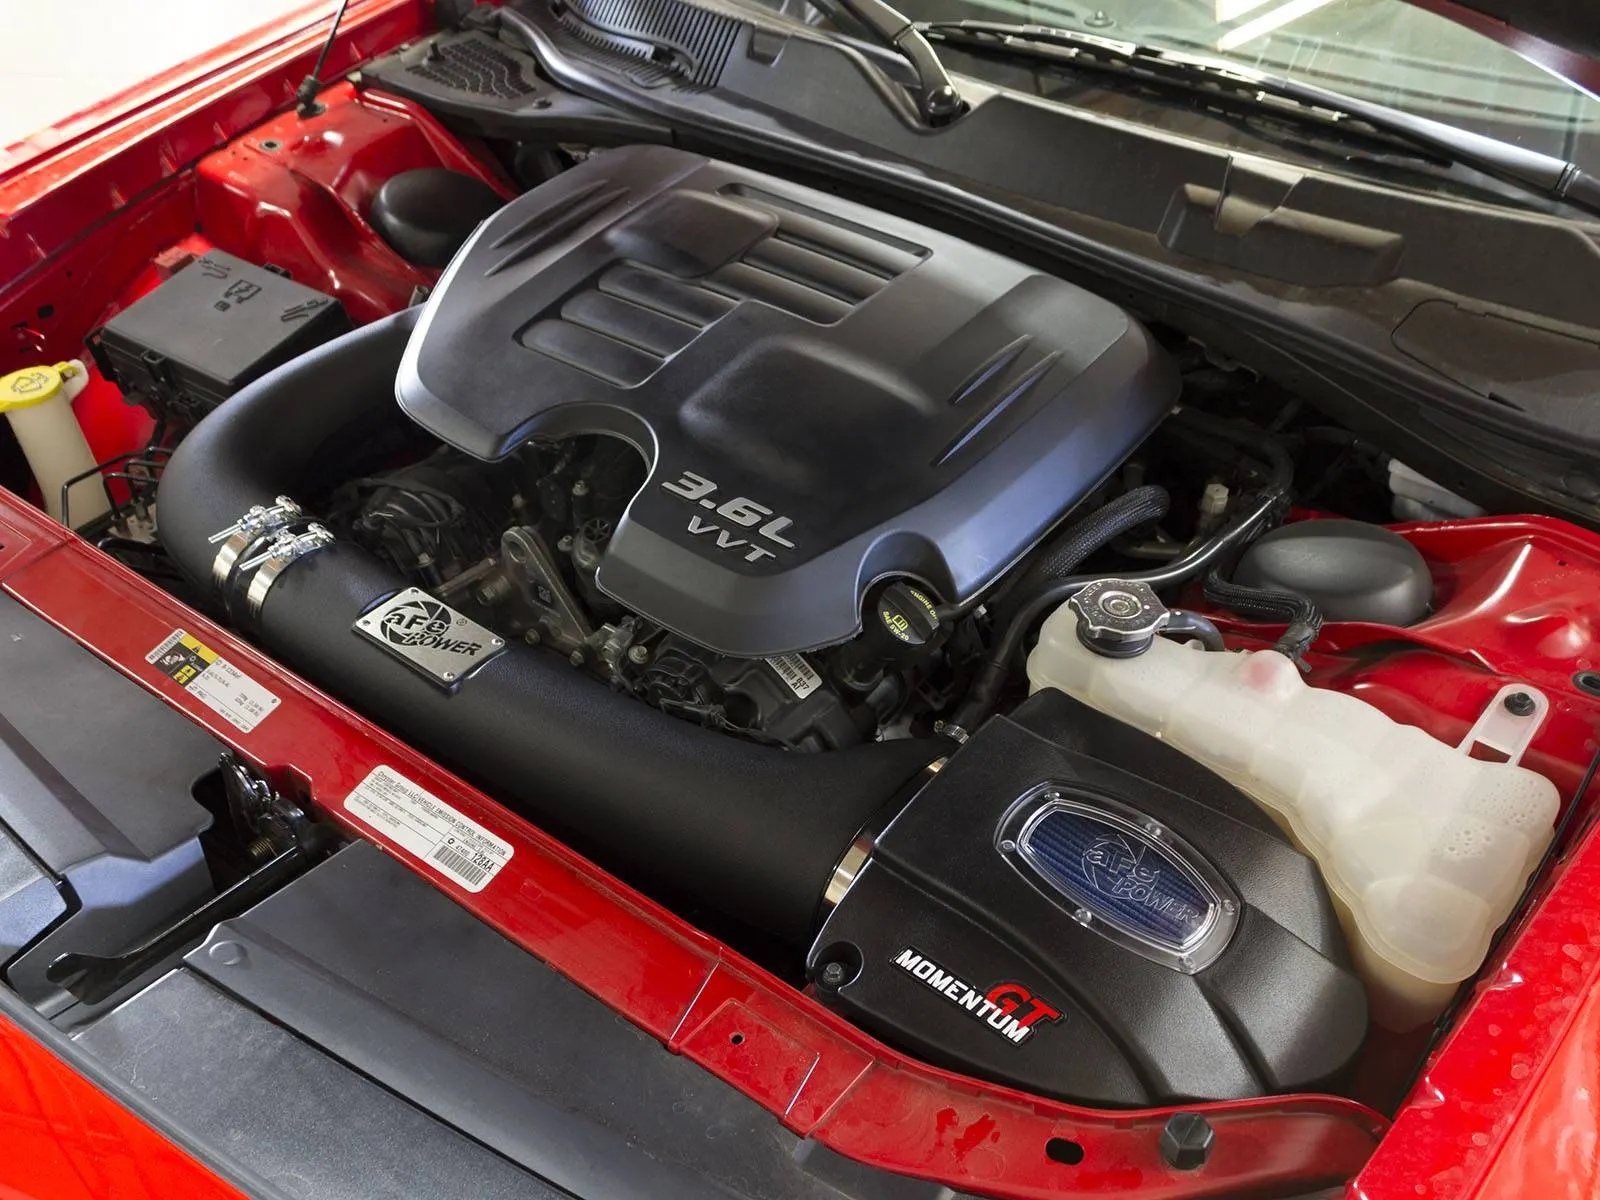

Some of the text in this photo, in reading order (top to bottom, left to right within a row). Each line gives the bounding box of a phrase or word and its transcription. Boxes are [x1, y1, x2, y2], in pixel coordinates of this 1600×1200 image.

[661, 470, 796, 549] 3.6L
[688, 515, 777, 562] VVT
[403, 632, 482, 656] POWER
[408, 789, 419, 801] LLC
[418, 794, 437, 811] VEHICLE
[435, 804, 457, 824] EMISSION
[454, 817, 476, 838] CONTROL
[475, 831, 508, 857] INFORMATION
[471, 852, 495, 872] 128AA
[894, 949, 1031, 1043] MOMENTUM
[985, 983, 1061, 1029] GT
